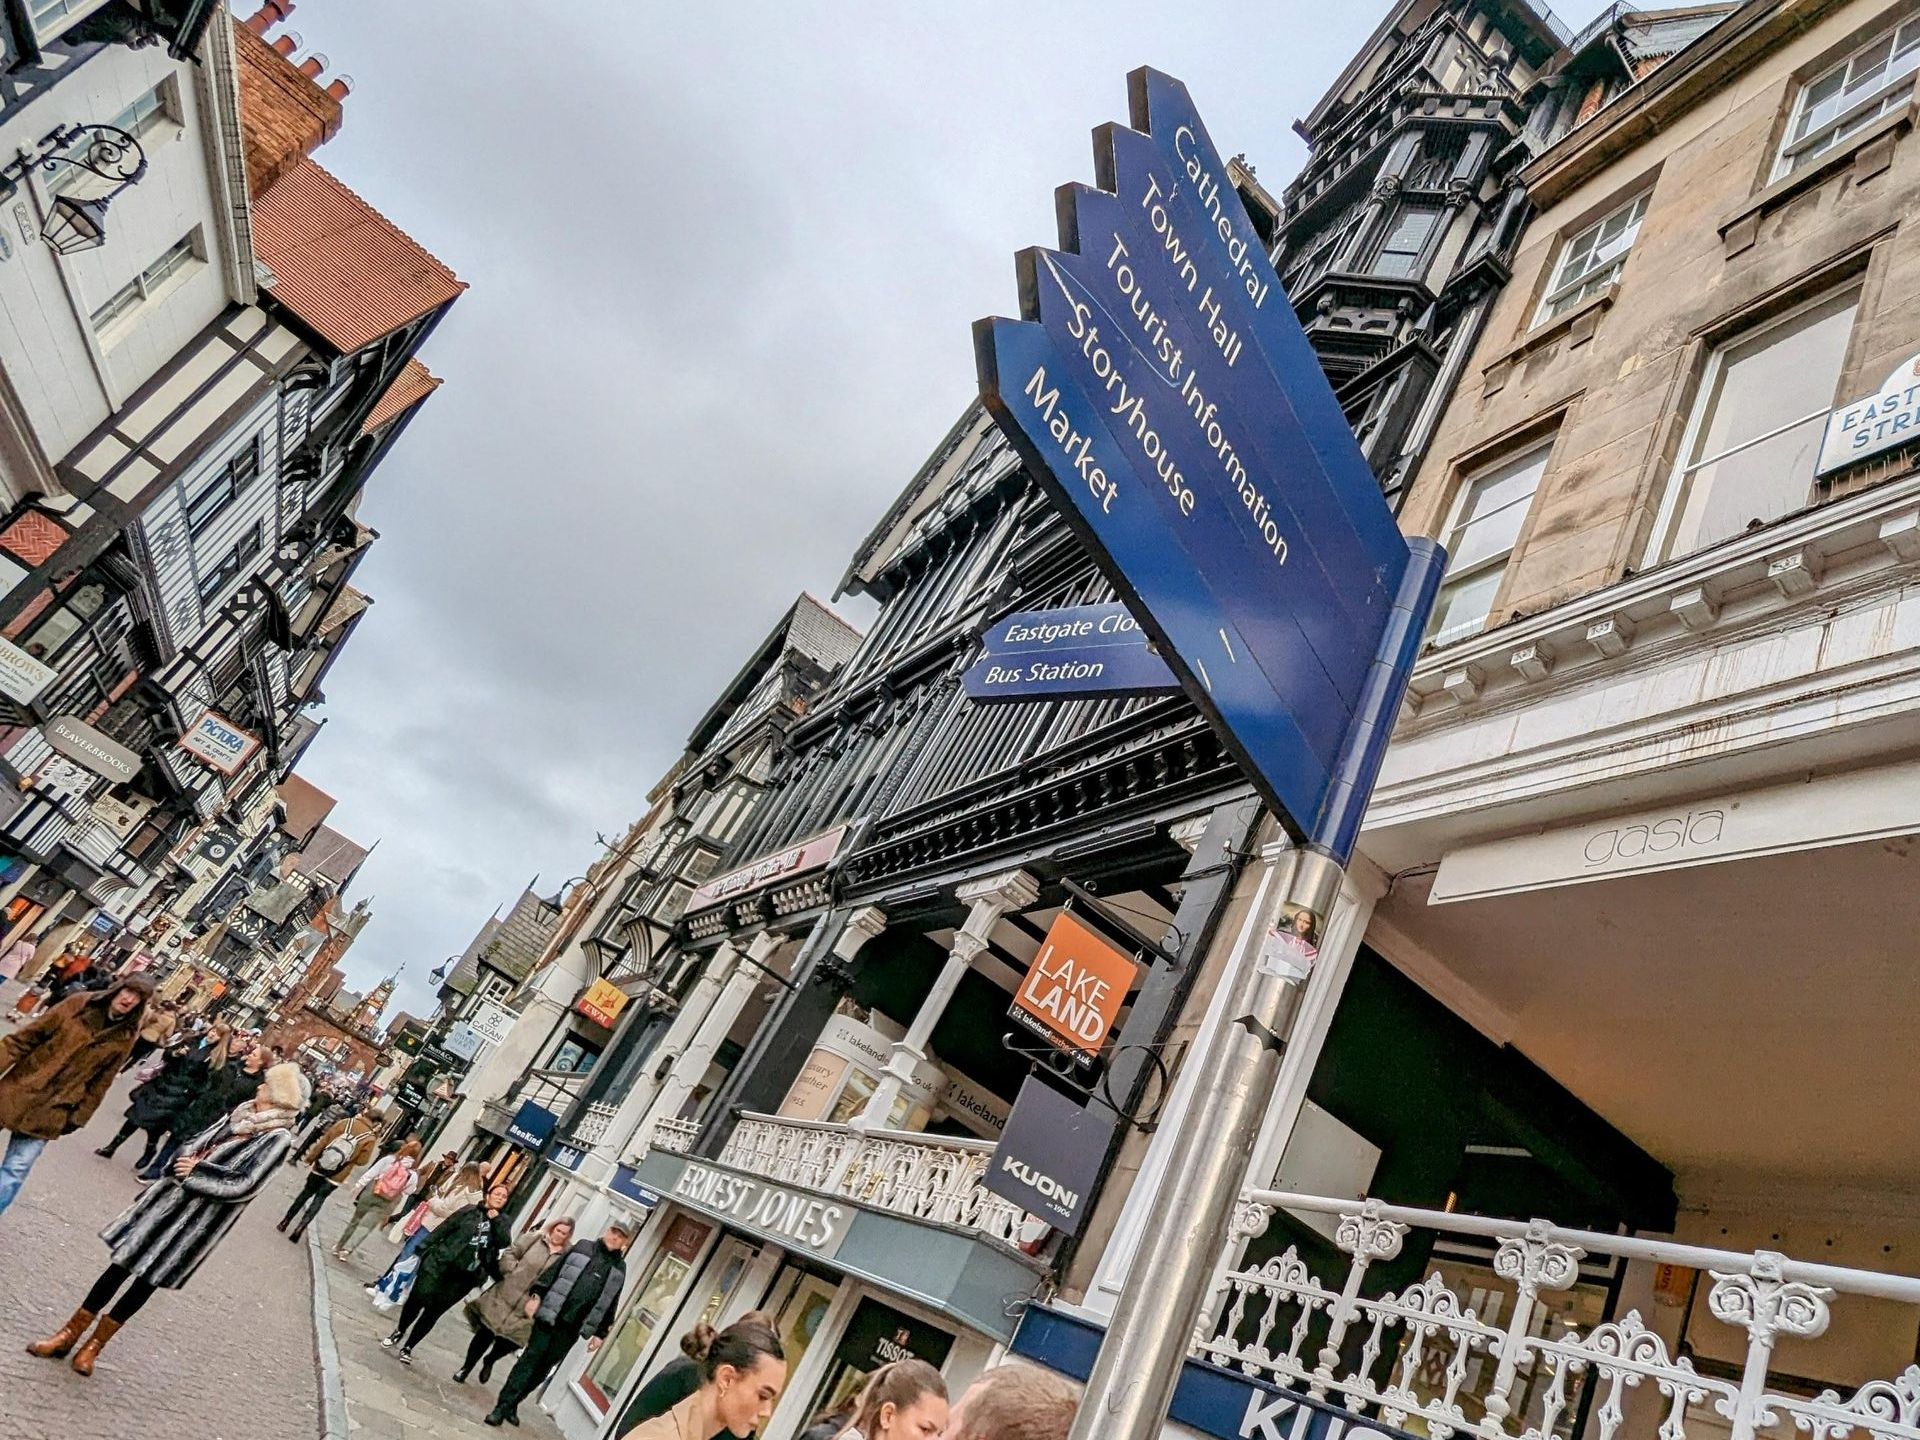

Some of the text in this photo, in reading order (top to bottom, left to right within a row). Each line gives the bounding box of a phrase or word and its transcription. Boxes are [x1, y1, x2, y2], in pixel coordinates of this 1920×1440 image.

[1175, 125, 1269, 308] Cathedral
[1140, 173, 1243, 368] Town Hall
[1066, 302, 1195, 517] Storyhouse
[1106, 233, 1289, 566] Tourist Information
[1024, 366, 1119, 515] Market
[1004, 620, 1094, 643] Eastgate
[984, 660, 1104, 684] Bus Station
[55, 724, 133, 774] BEAVERBROOKS
[1584, 809, 1724, 867] gasia
[1023, 971, 1104, 1042] LAND
[1037, 944, 1111, 1013] LAKE
[472, 1020, 504, 1041] CAVANI
[584, 1005, 608, 1025] EWM
[675, 1164, 843, 1247] ERNEST JONES
[1002, 1155, 1079, 1210] KUONI
[1053, 1204, 1071, 1218] 1906
